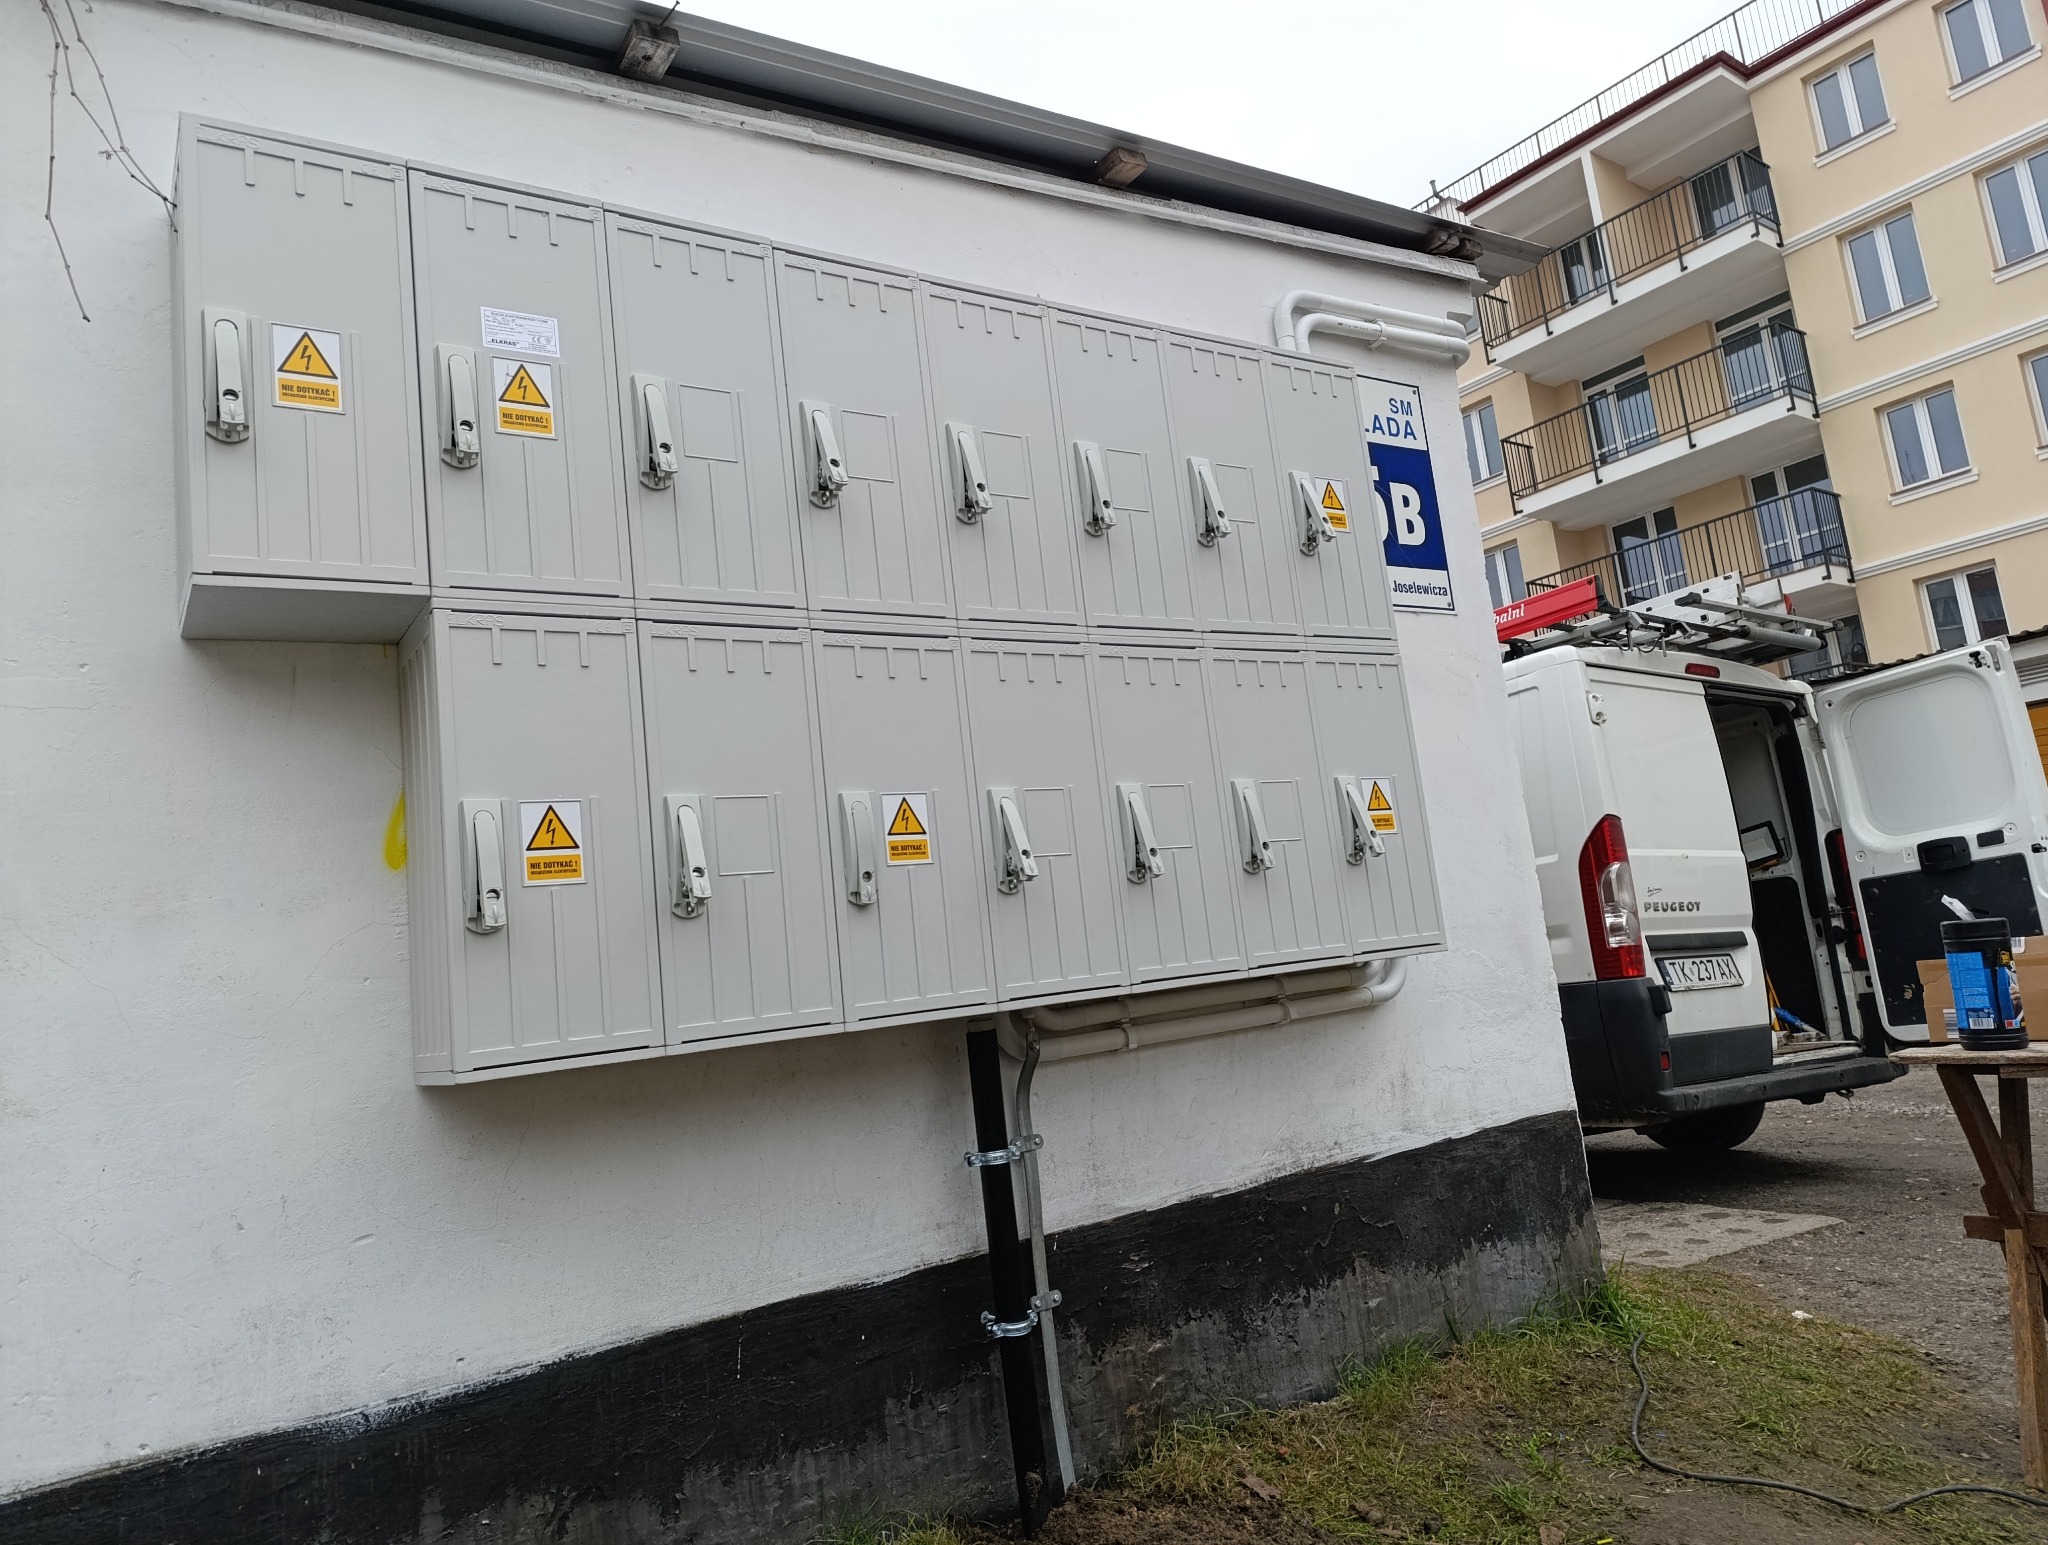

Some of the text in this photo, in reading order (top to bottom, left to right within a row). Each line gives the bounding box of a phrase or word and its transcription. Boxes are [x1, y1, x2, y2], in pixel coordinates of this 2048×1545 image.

[281, 384, 295, 392] NIE
[296, 385, 330, 397] DOTYKAĆ
[1389, 398, 1413, 417] SM
[502, 412, 514, 420] NIE
[515, 413, 544, 424] DOTYKAĆ
[1365, 414, 1418, 441] ADA
[1392, 579, 1448, 599] Joselewicza
[901, 843, 922, 851] DOTYKAĆ
[543, 860, 573, 868] DOTYKAĆ
[1643, 901, 1701, 913] PEUGEOT
[1668, 958, 1737, 983] TK 237AX
